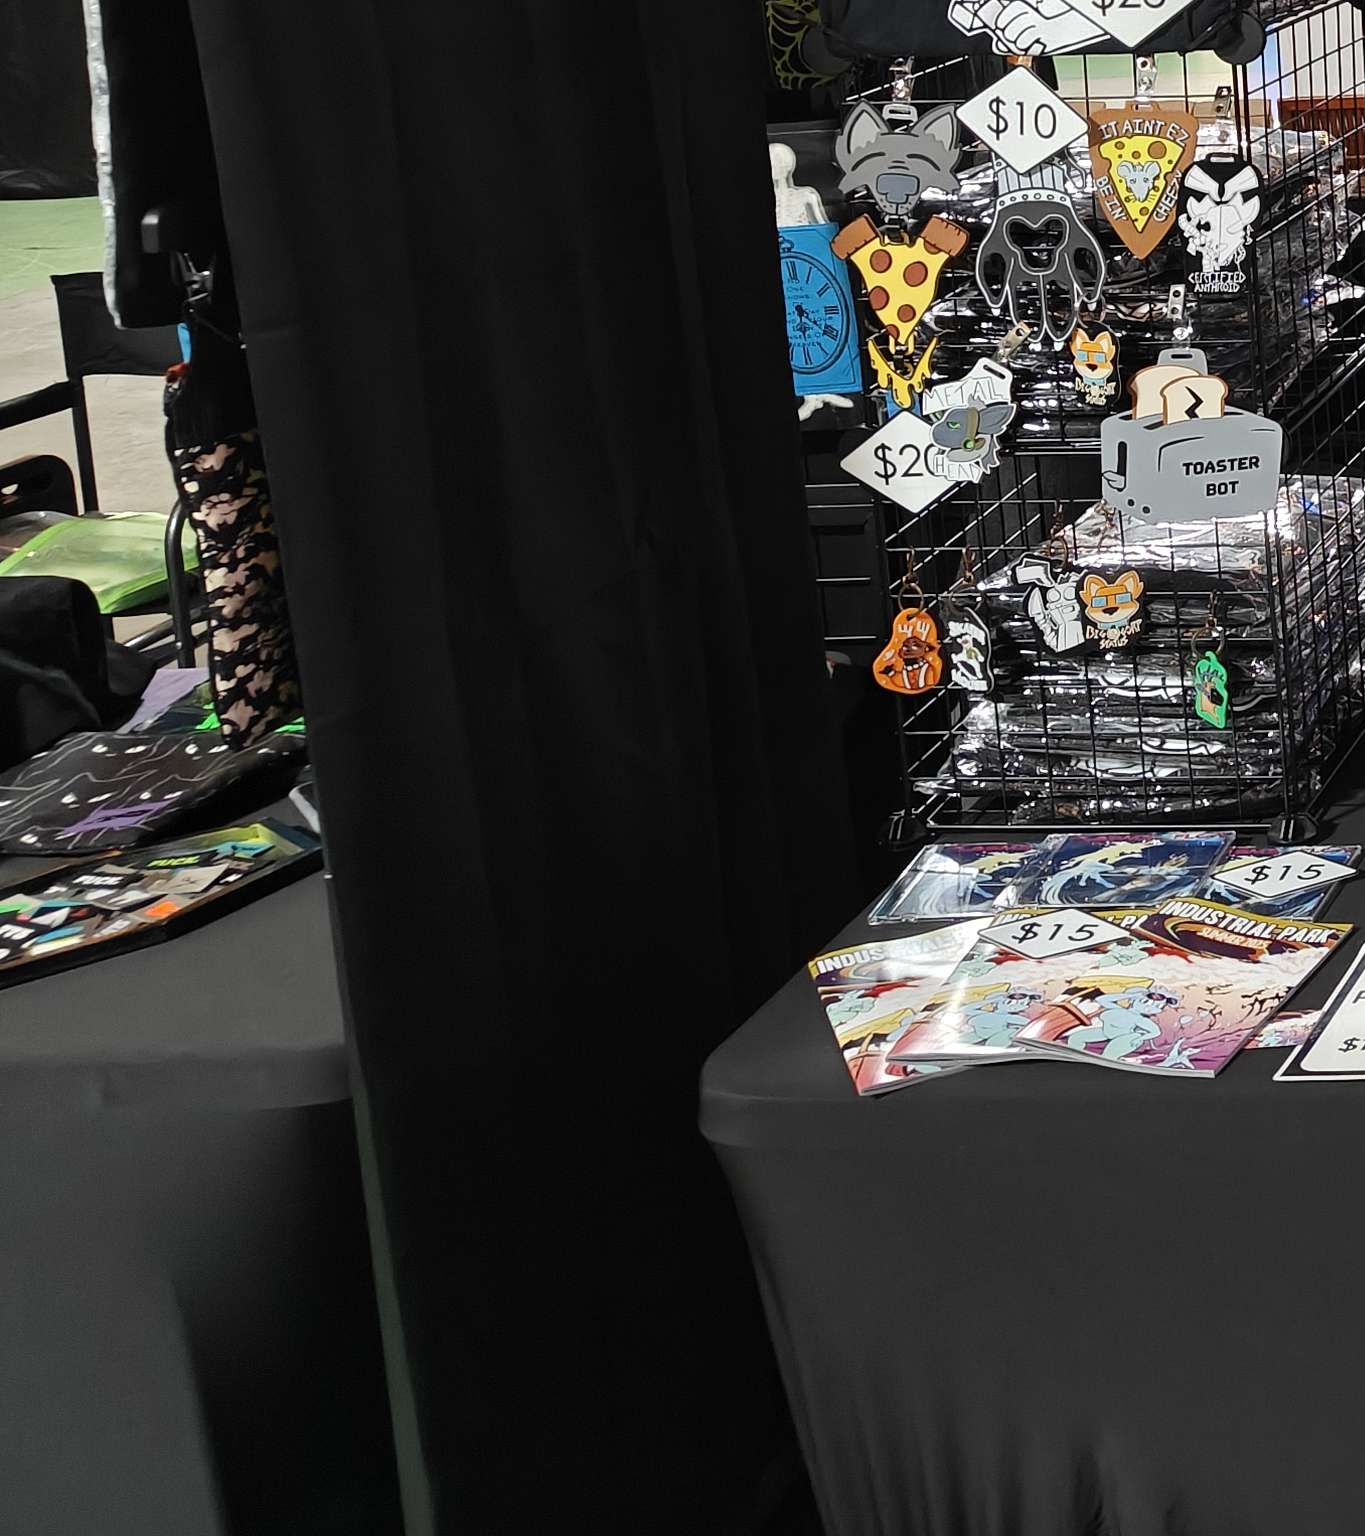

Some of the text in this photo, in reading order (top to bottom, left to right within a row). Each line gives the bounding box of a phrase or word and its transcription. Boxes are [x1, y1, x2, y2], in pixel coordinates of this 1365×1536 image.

[987, 96, 1058, 141] $10
[1100, 119, 1190, 146] IT AINT EZ
[1188, 270, 1247, 284] CERTIFIED
[1194, 283, 1241, 293] ANTHROID
[1182, 456, 1261, 476] TOASTER
[1206, 481, 1240, 497] BOT
[1244, 863, 1327, 885] $15
[1011, 922, 1100, 944] $15
[1199, 927, 1245, 945] SUMMER
